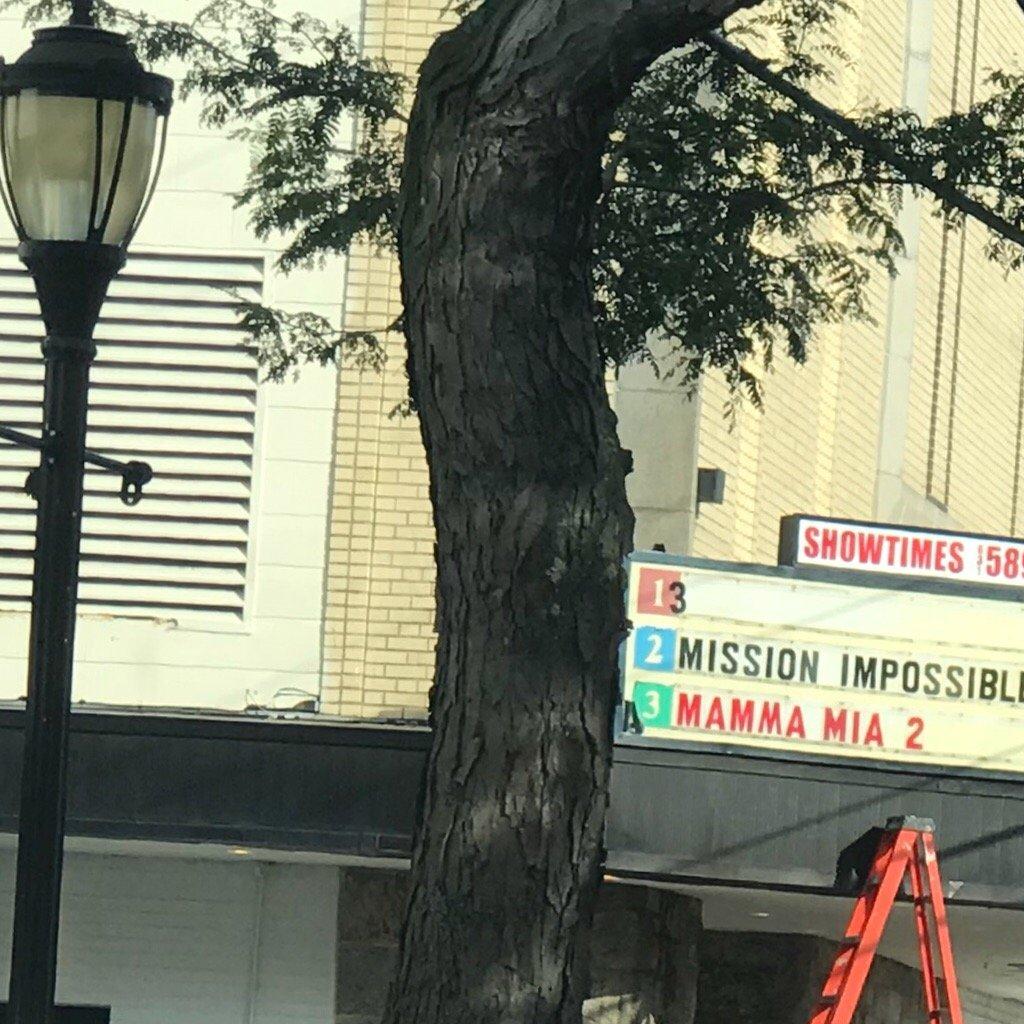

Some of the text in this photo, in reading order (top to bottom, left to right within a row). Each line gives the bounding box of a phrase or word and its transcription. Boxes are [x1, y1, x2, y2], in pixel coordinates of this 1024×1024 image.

[803, 526, 964, 574] SHOWTIMES
[644, 633, 664, 665] 2
[678, 636, 819, 683] MISSION
[641, 689, 925, 750] 3 MAMMA MIA 2
